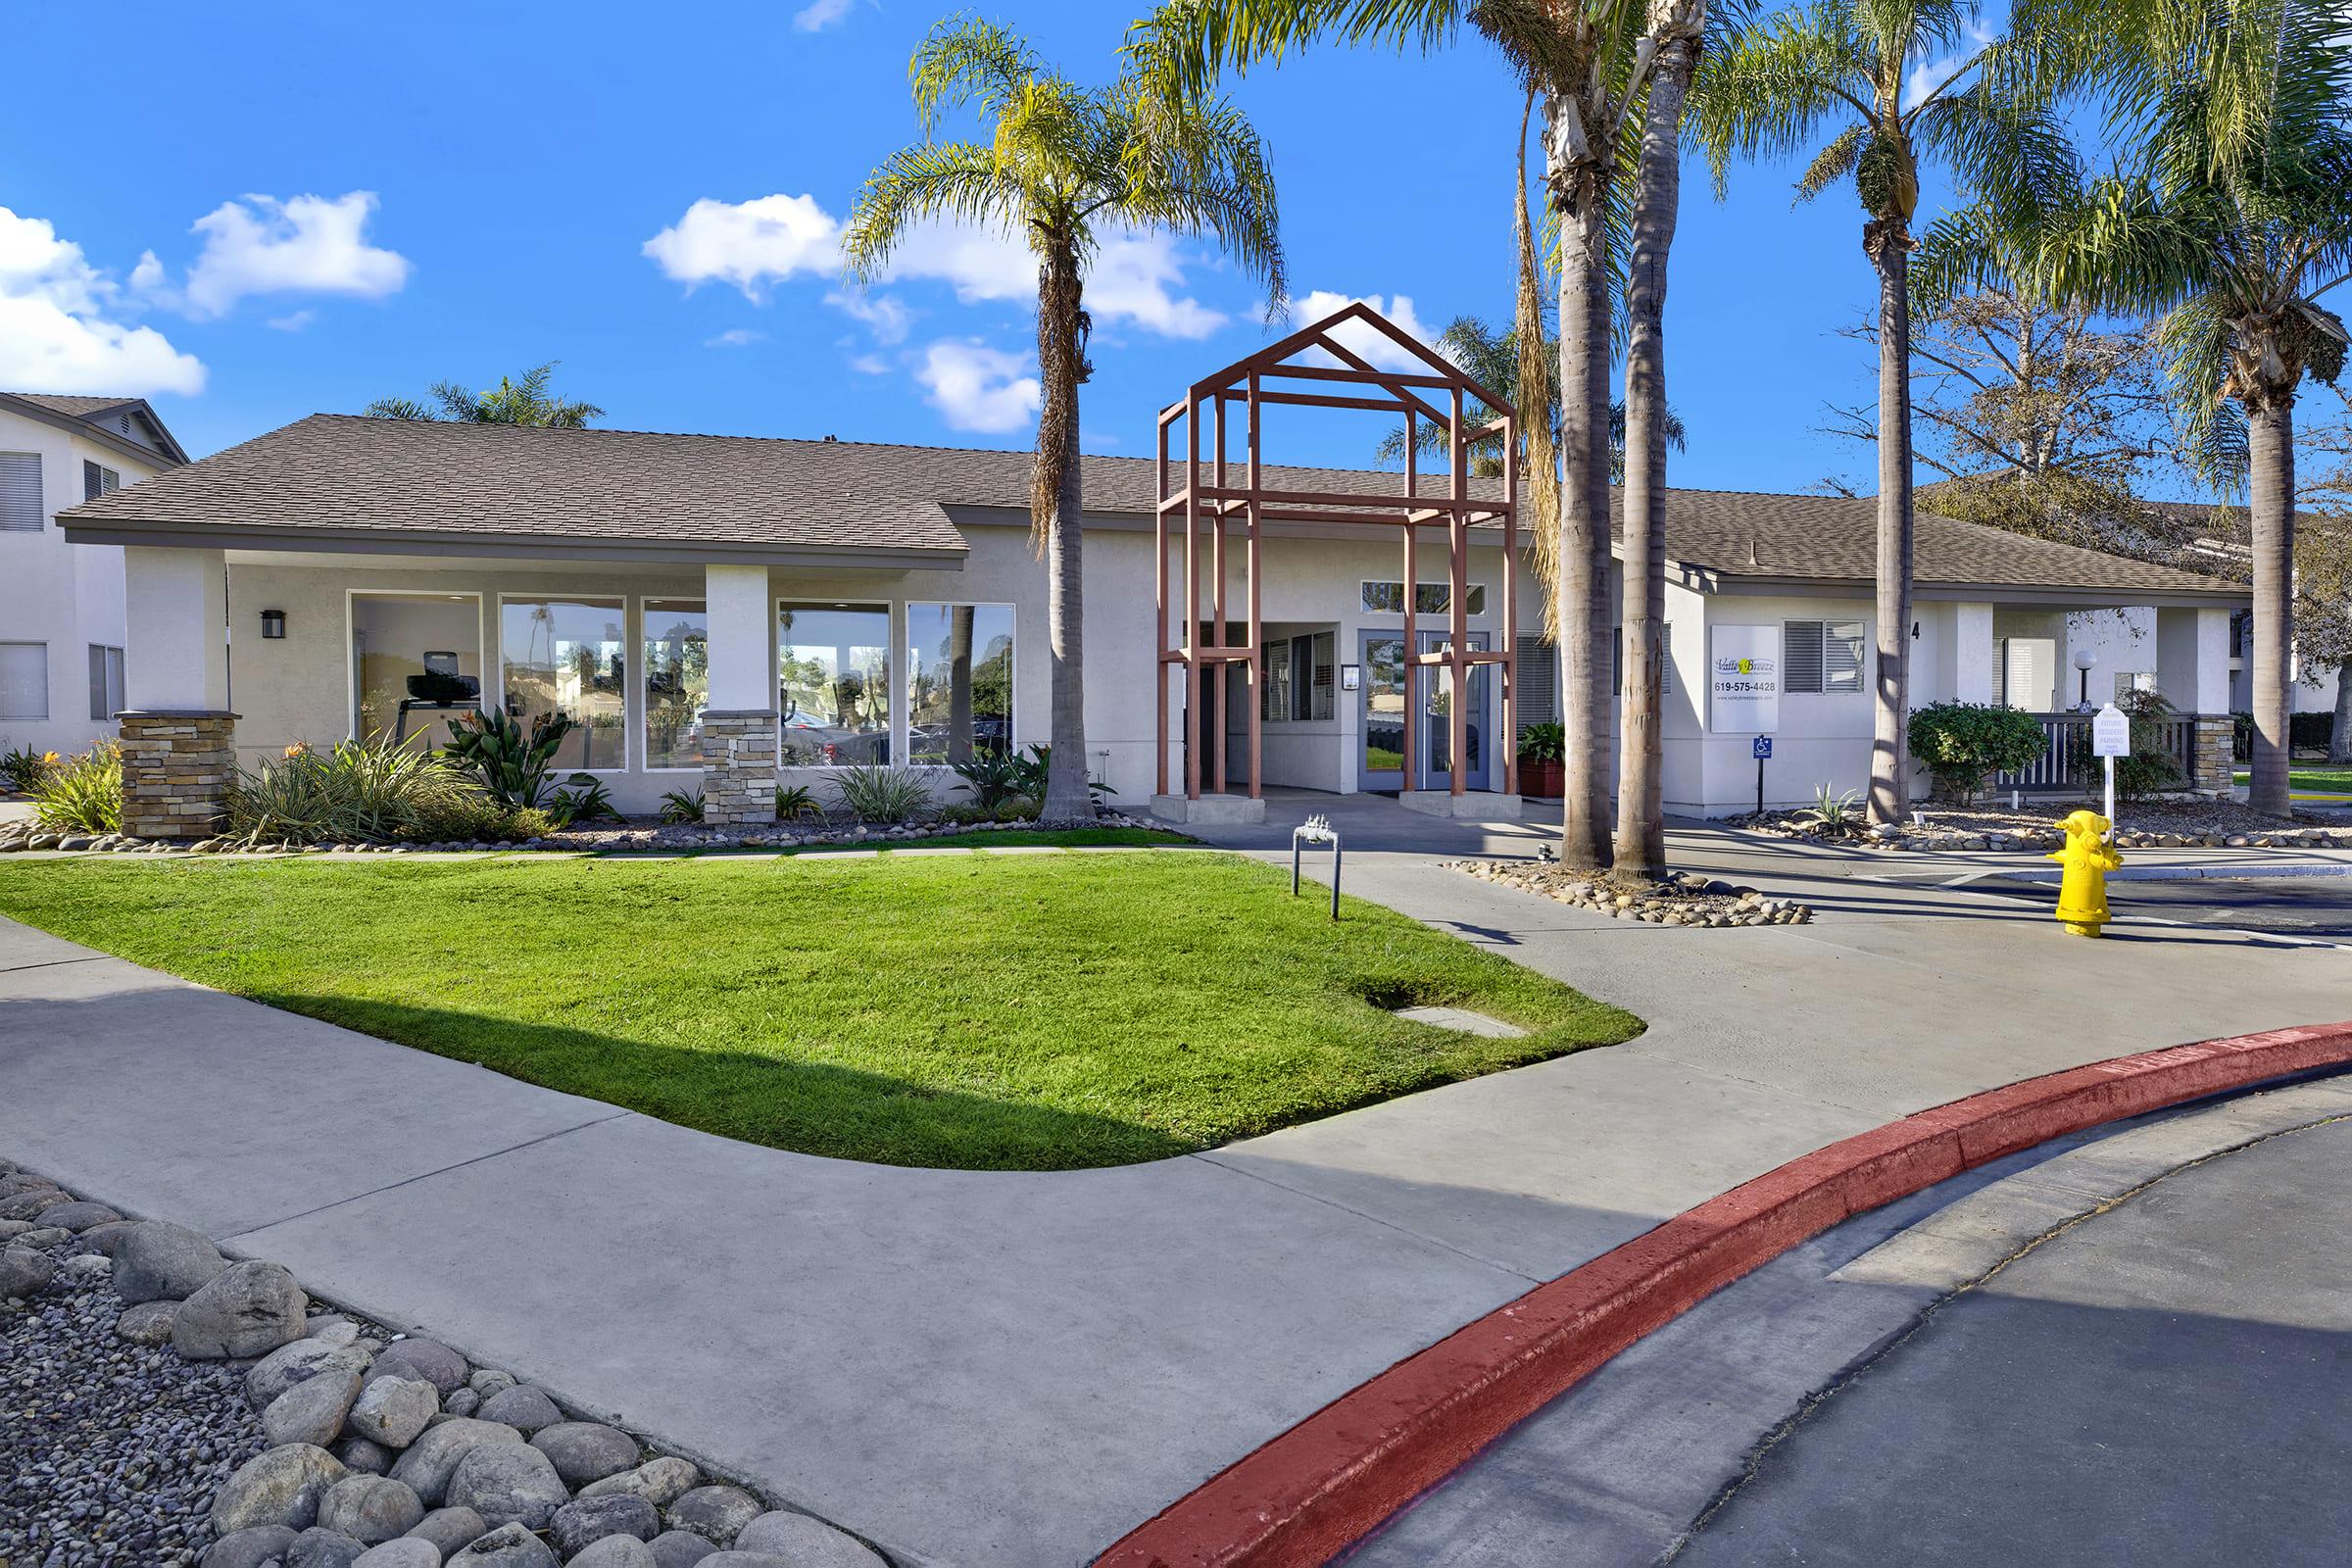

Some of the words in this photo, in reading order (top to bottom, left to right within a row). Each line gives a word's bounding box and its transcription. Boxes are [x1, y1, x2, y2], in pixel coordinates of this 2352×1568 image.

[1912, 621, 1921, 639] 4
[1716, 658, 1742, 674] Valley
[1745, 660, 1775, 670] Breeze
[1715, 682, 1776, 691] 619-575-4428
